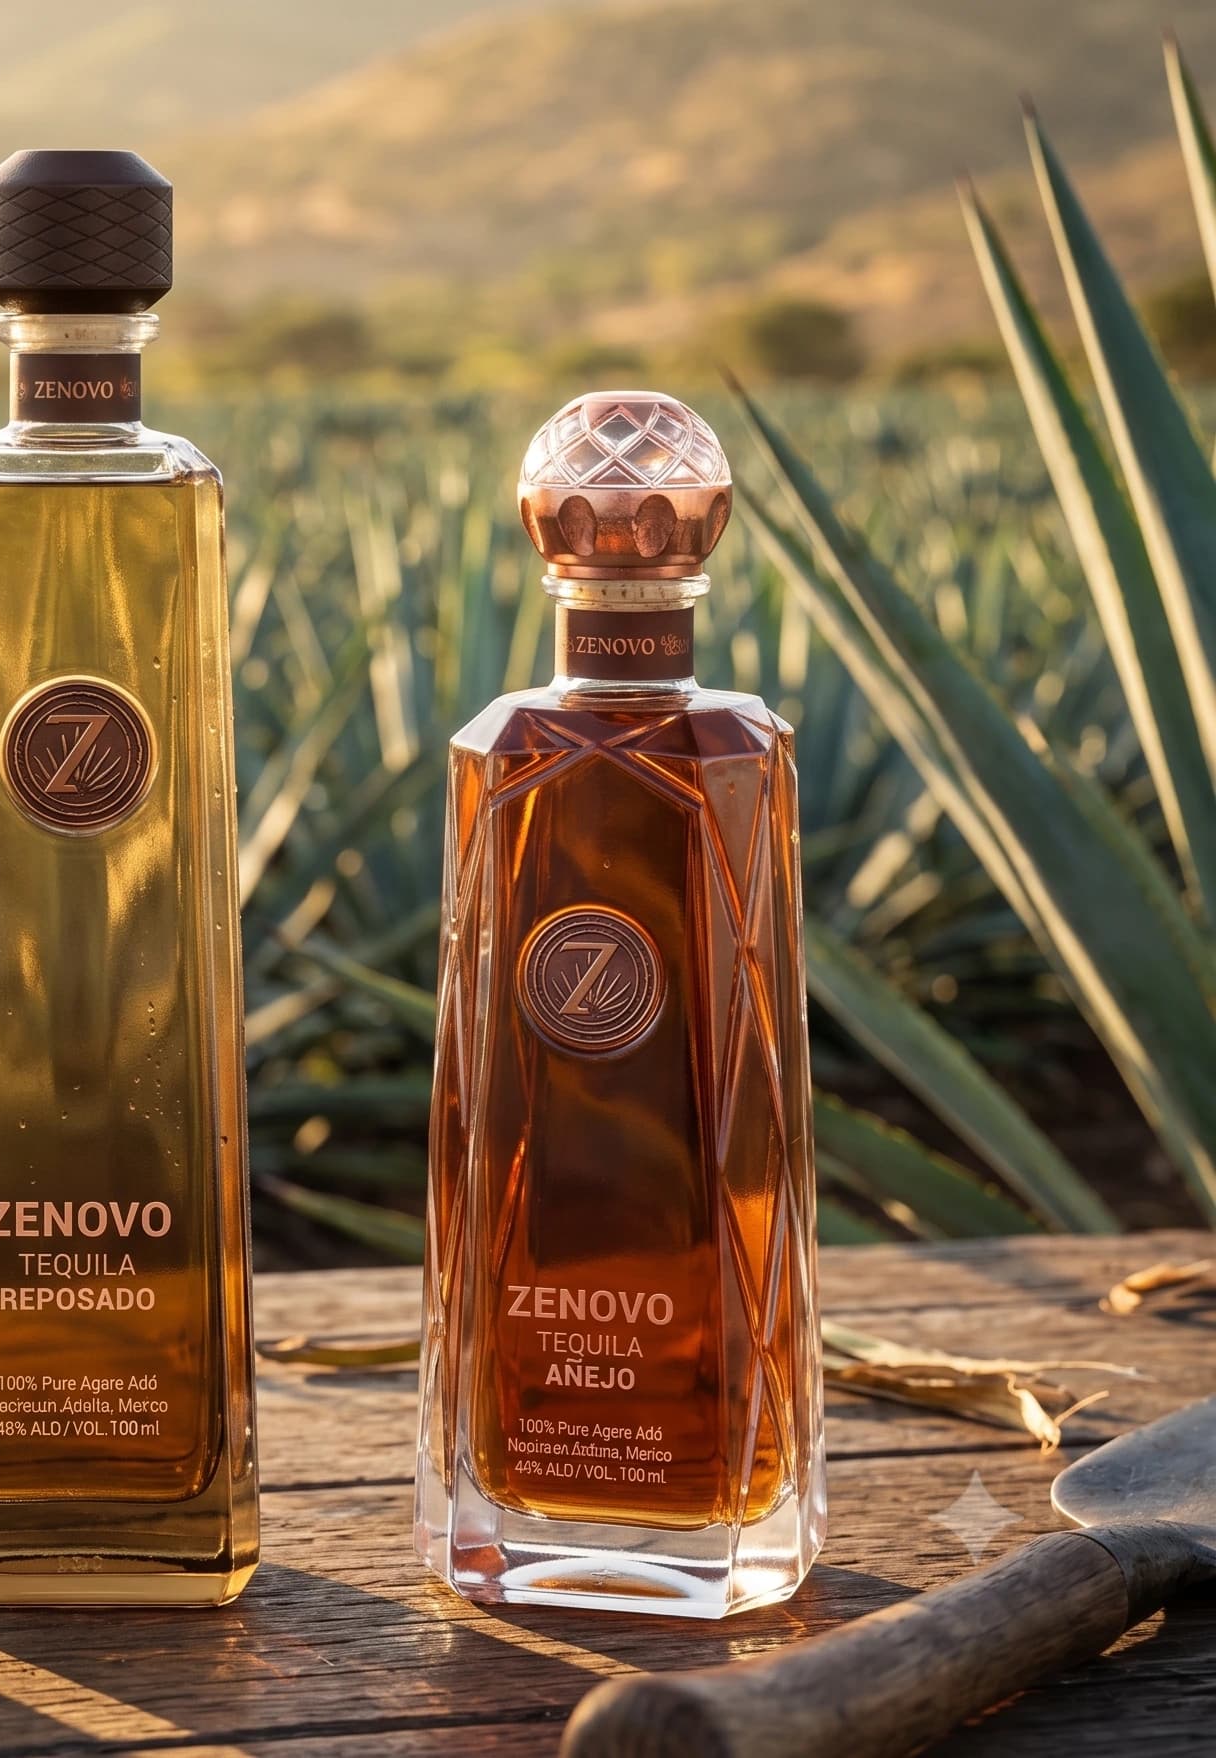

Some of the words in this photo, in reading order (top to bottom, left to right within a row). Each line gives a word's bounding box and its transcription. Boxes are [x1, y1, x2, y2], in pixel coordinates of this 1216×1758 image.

[34, 381, 114, 399] ZENOVO
[575, 636, 655, 656] ZENOVO
[18, 1253, 137, 1279] TEQUILA
[0, 1287, 156, 1311] REPOSADO
[507, 1285, 674, 1326] ZENOVO
[536, 1331, 644, 1358] TEQUILA
[42, 1375, 77, 1391] Pure
[80, 1375, 124, 1394] Agare
[545, 1357, 635, 1390] AÑEJO
[140, 1420, 160, 1436] ml
[518, 1418, 555, 1434] 100%
[558, 1421, 590, 1437] Pure
[592, 1423, 632, 1442] Agere
